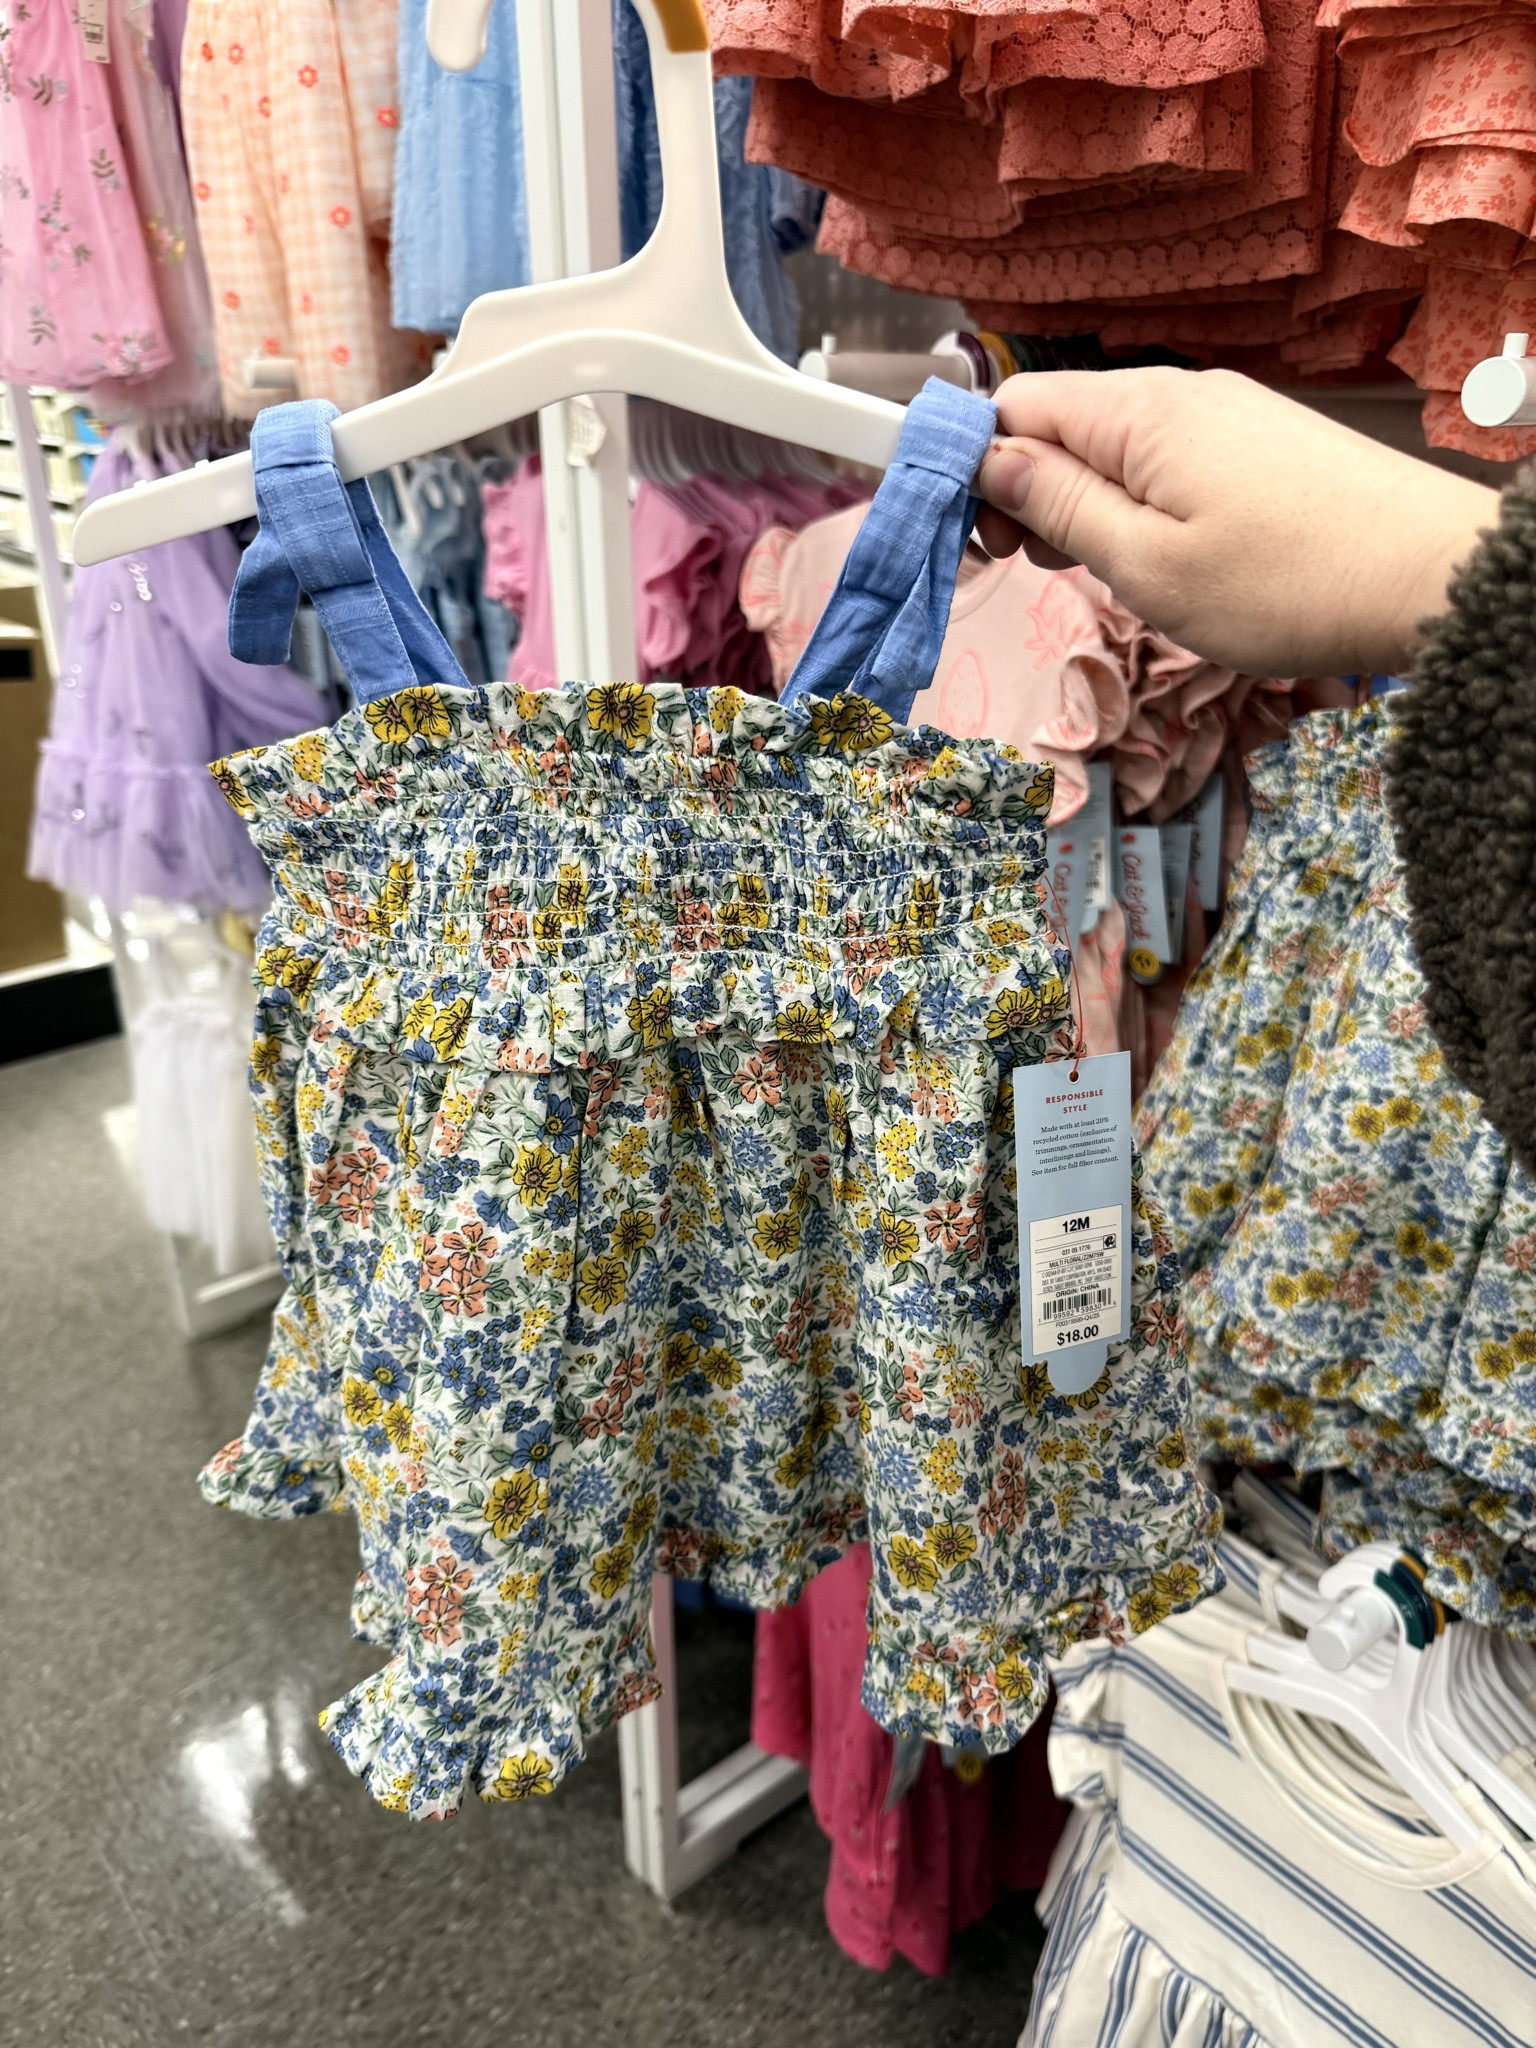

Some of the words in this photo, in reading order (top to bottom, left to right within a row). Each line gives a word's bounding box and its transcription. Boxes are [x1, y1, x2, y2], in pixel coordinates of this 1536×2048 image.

[1121, 852, 1142, 881] Cat
[1125, 881, 1144, 903] &
[1119, 900, 1150, 939] Jack
[1045, 1089, 1103, 1104] RESPONSIBLE
[1063, 1104, 1087, 1114] STYLE
[1041, 1125, 1058, 1133] Made
[1059, 1122, 1072, 1131] with
[1081, 1119, 1095, 1127] least
[1033, 1135, 1058, 1146] recycled
[1059, 1132, 1079, 1140] cotton
[1080, 1127, 1110, 1137] (exclusive
[1035, 1145, 1068, 1155] trimmings,
[1069, 1137, 1115, 1149] ornamentation,
[1039, 1152, 1074, 1165] interlinings
[1075, 1150, 1086, 1158] and
[1086, 1146, 1111, 1157] linings).
[1031, 1168, 1043, 1176] See
[1044, 1166, 1057, 1174] item
[1079, 1159, 1094, 1167] fiber
[1094, 1155, 1119, 1165] content.
[1062, 1216, 1090, 1233] 12M
[1062, 1247, 1071, 1256] 031
[1049, 1260, 1063, 1268] MULTI
[1056, 1288, 1078, 1298] ORIGIN:
[1080, 1283, 1099, 1292] CHINA
[1053, 1310, 1074, 1320] 99592
[1081, 1303, 1101, 1314] 59830
[1057, 1324, 1099, 1346] $18.00
